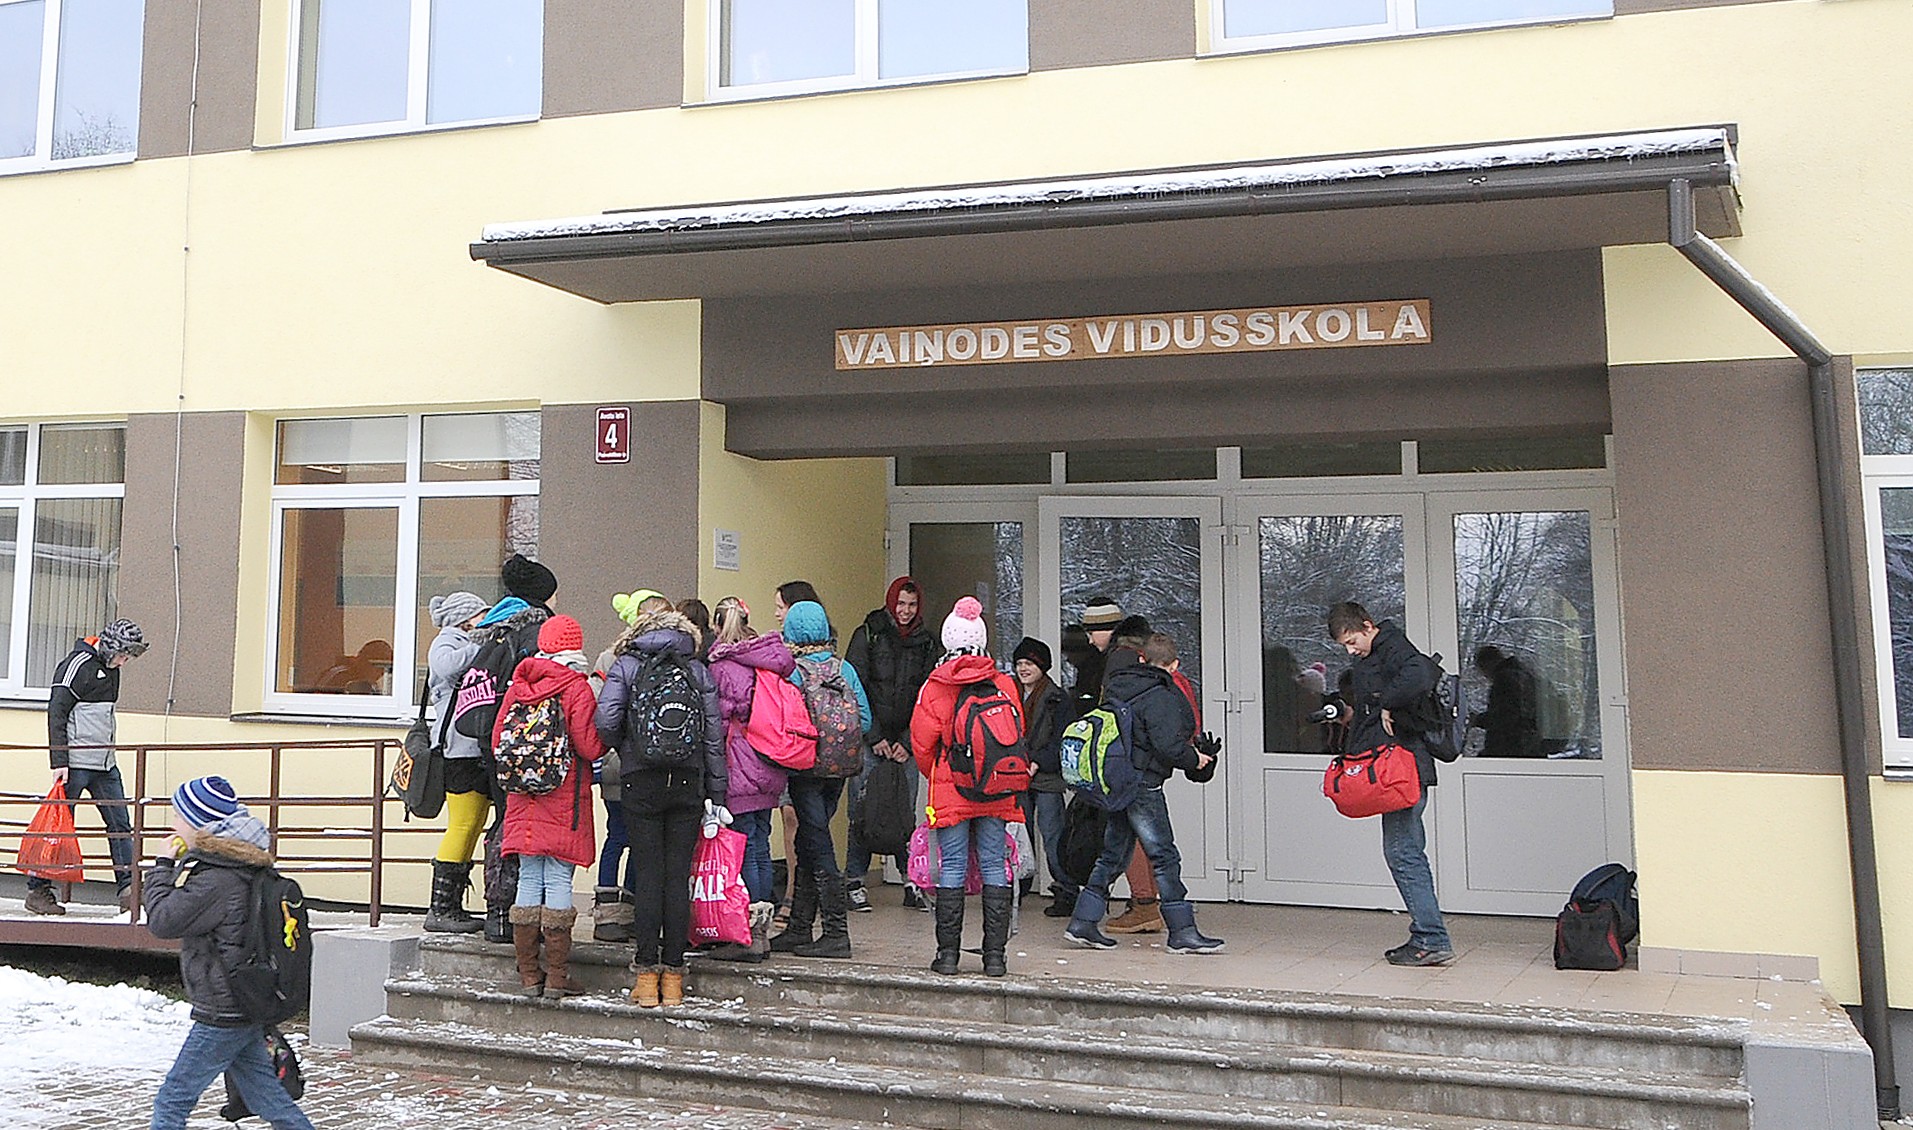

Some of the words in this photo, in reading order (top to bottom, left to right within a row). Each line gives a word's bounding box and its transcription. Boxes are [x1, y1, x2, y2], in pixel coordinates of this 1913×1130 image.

[838, 323, 1072, 367] VAIŅODES
[1085, 304, 1428, 354] VIDUSSKOLA
[604, 423, 618, 449] 4
